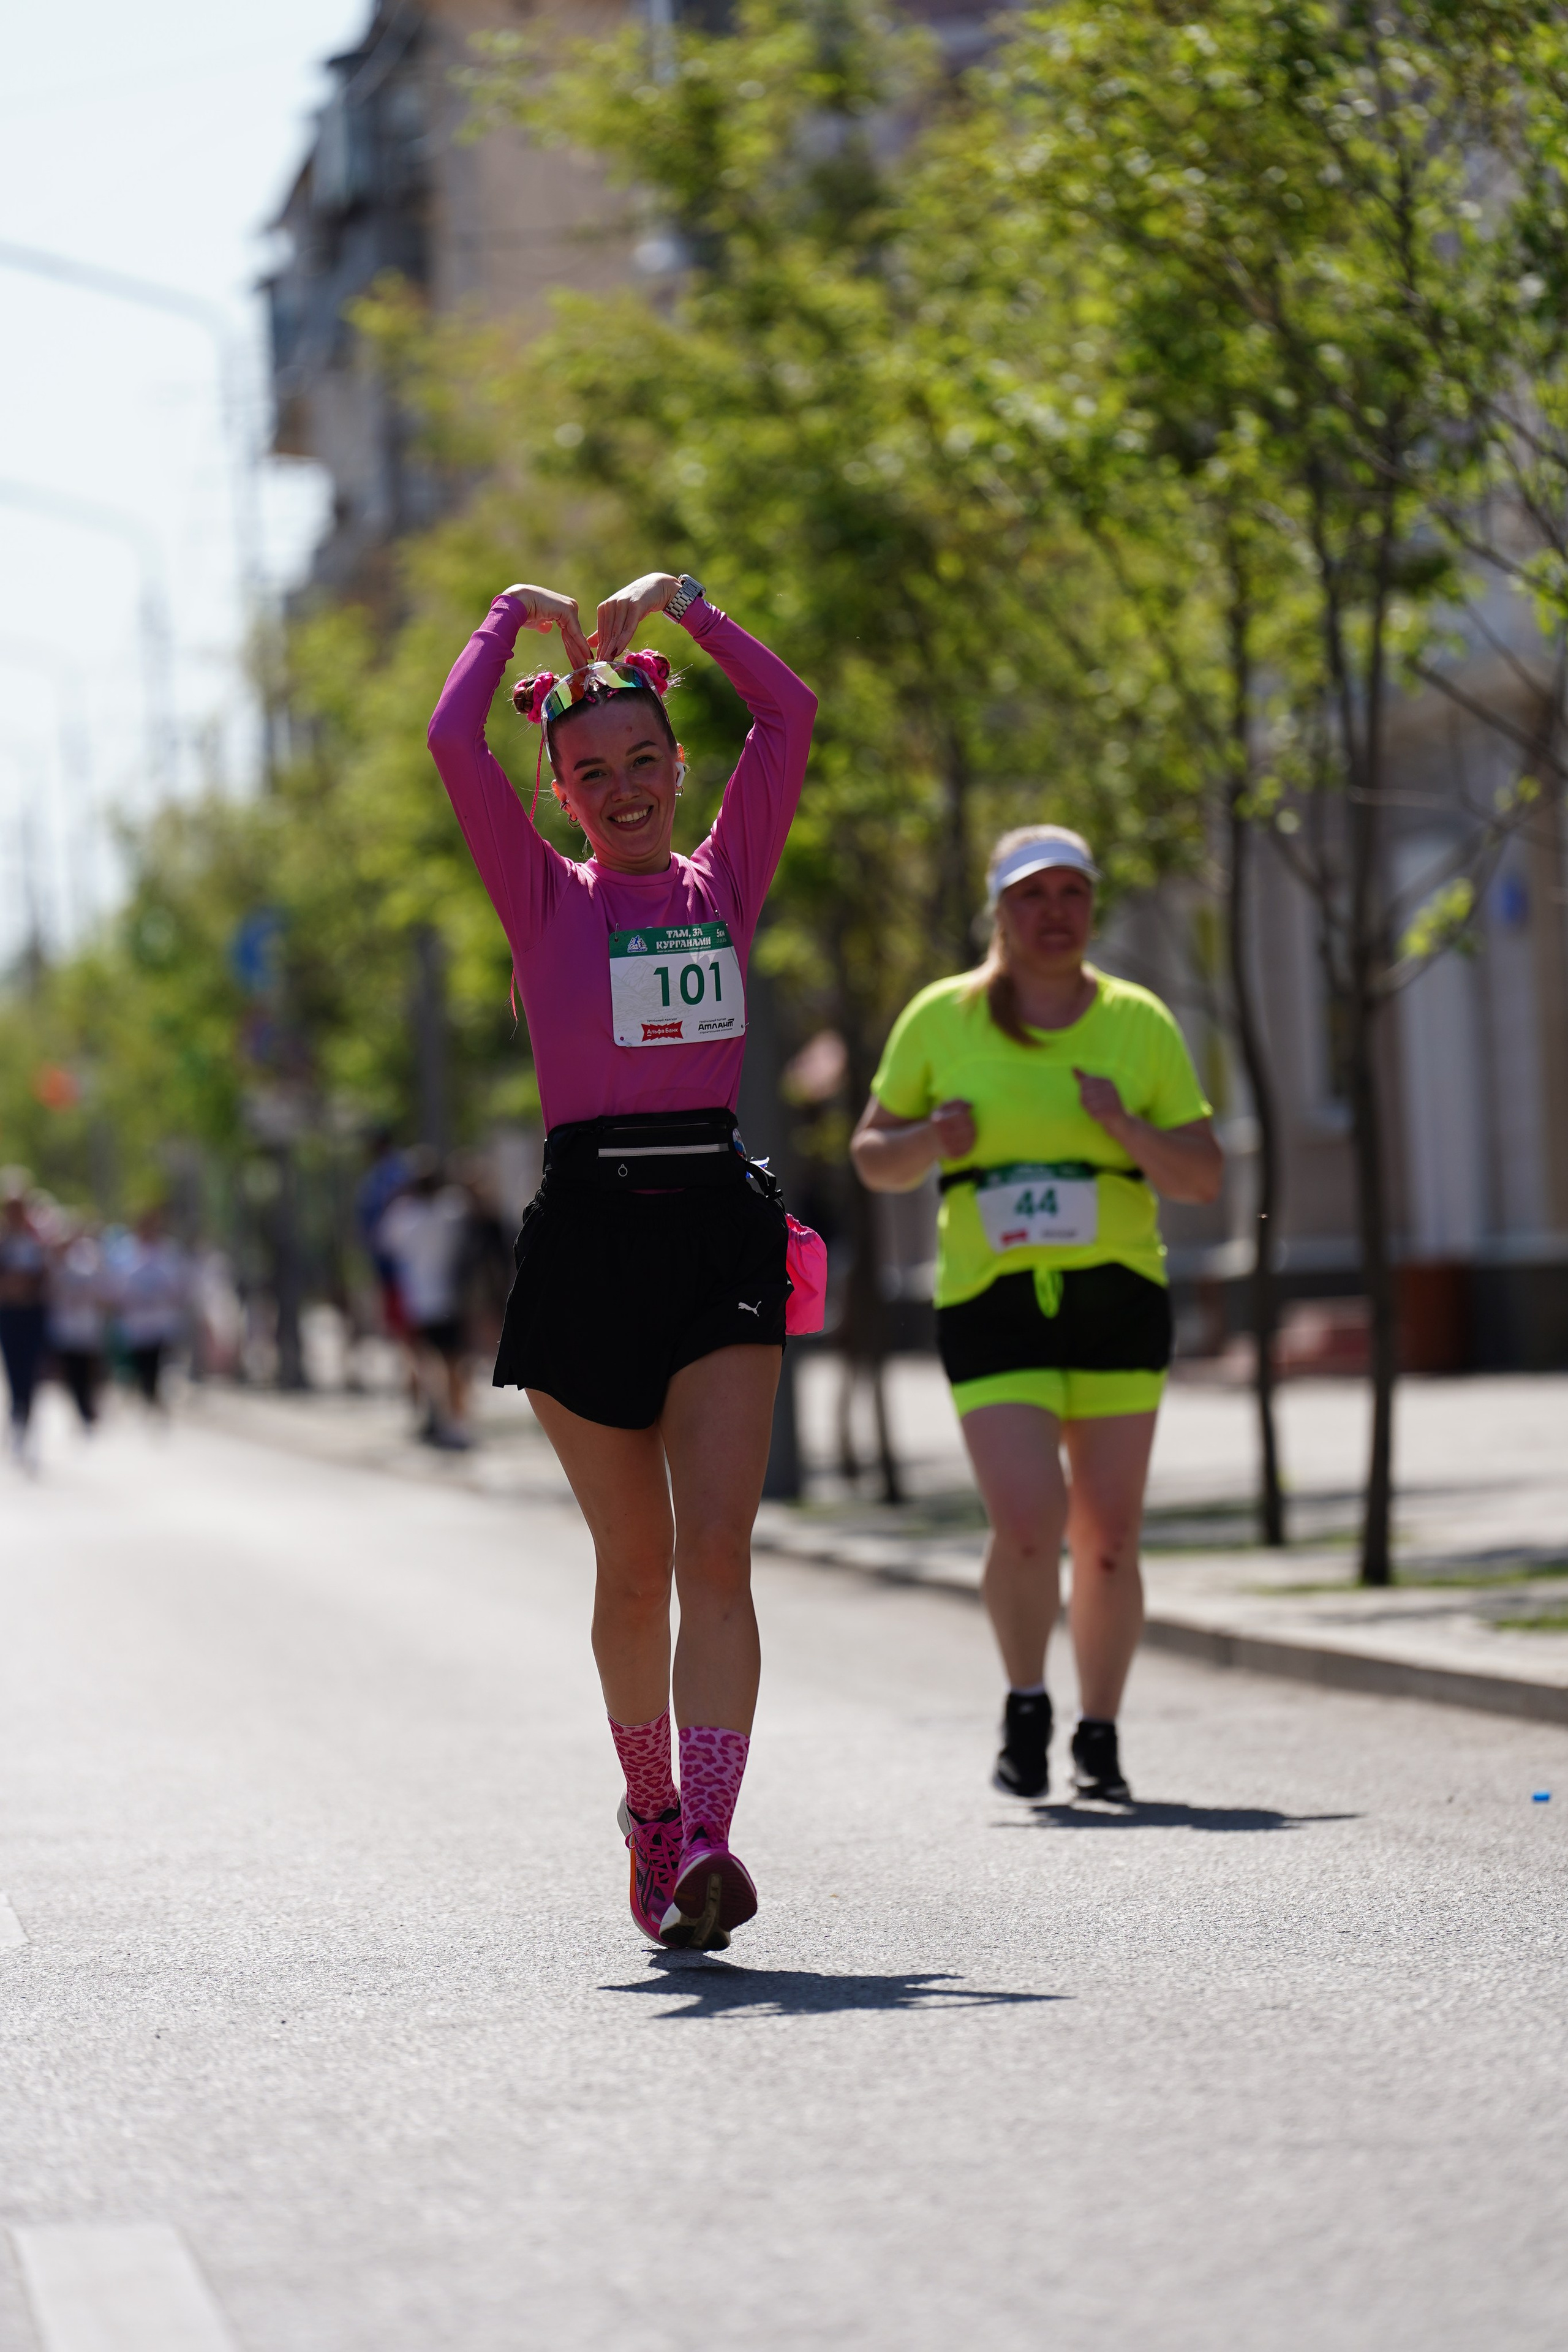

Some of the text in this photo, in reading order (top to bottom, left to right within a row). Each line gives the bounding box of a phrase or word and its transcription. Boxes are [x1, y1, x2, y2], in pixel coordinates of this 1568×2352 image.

[656, 937, 711, 949] КУРГАНАМИ
[666, 928, 703, 939] ТАМ, ЗА
[654, 962, 722, 1006] 101
[1016, 1188, 1058, 1216] 44
